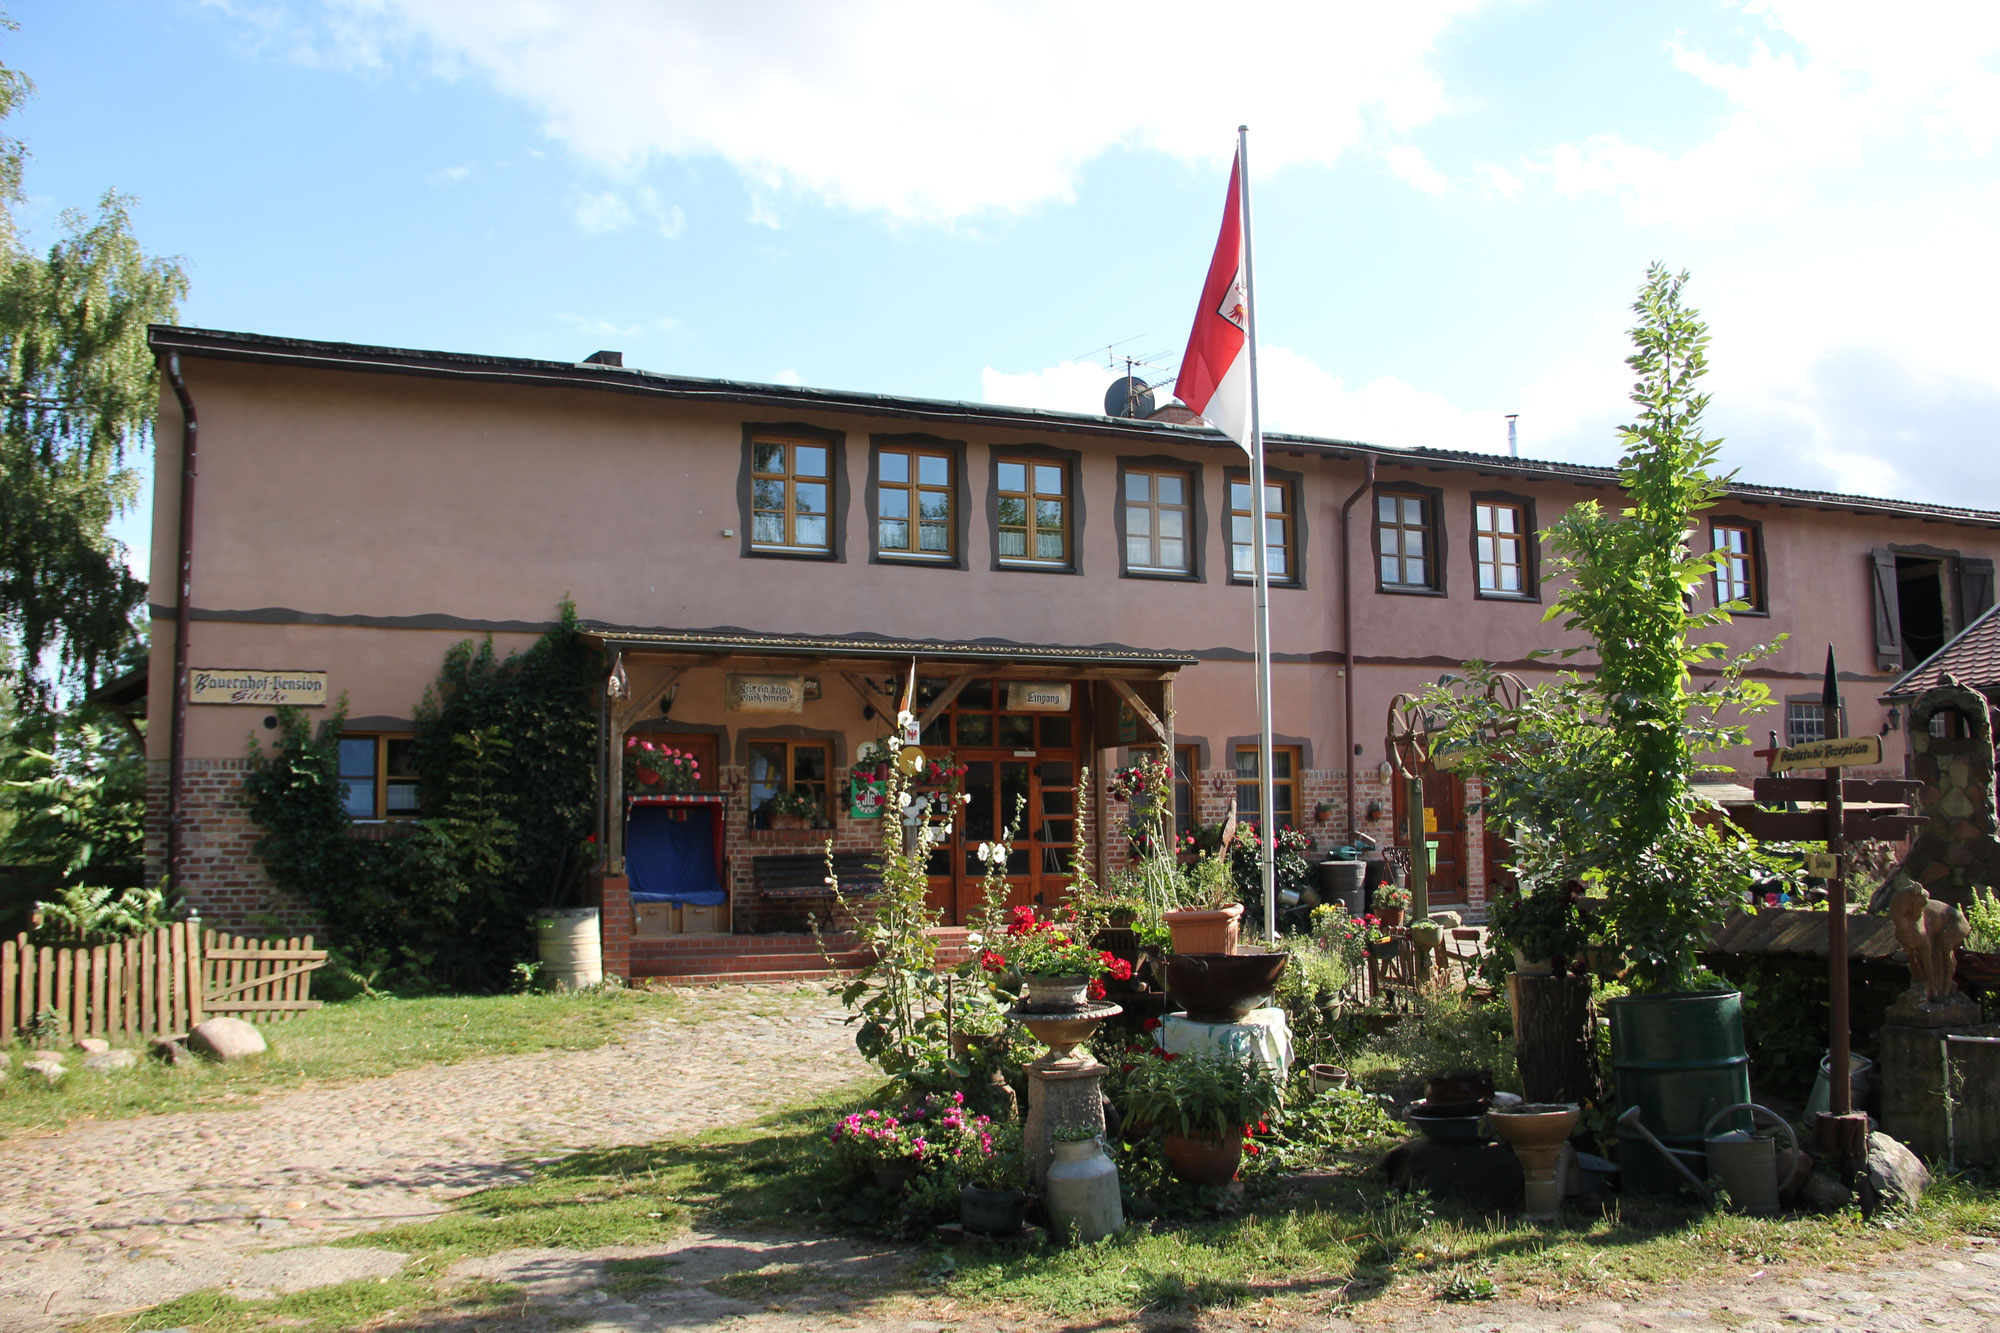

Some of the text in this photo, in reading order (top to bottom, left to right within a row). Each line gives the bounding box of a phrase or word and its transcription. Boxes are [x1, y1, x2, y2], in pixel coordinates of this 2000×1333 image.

[195, 673, 322, 693] Bauernhof-Pension
[763, 692, 788, 703] hinein
[1027, 691, 1060, 704] Eingang
